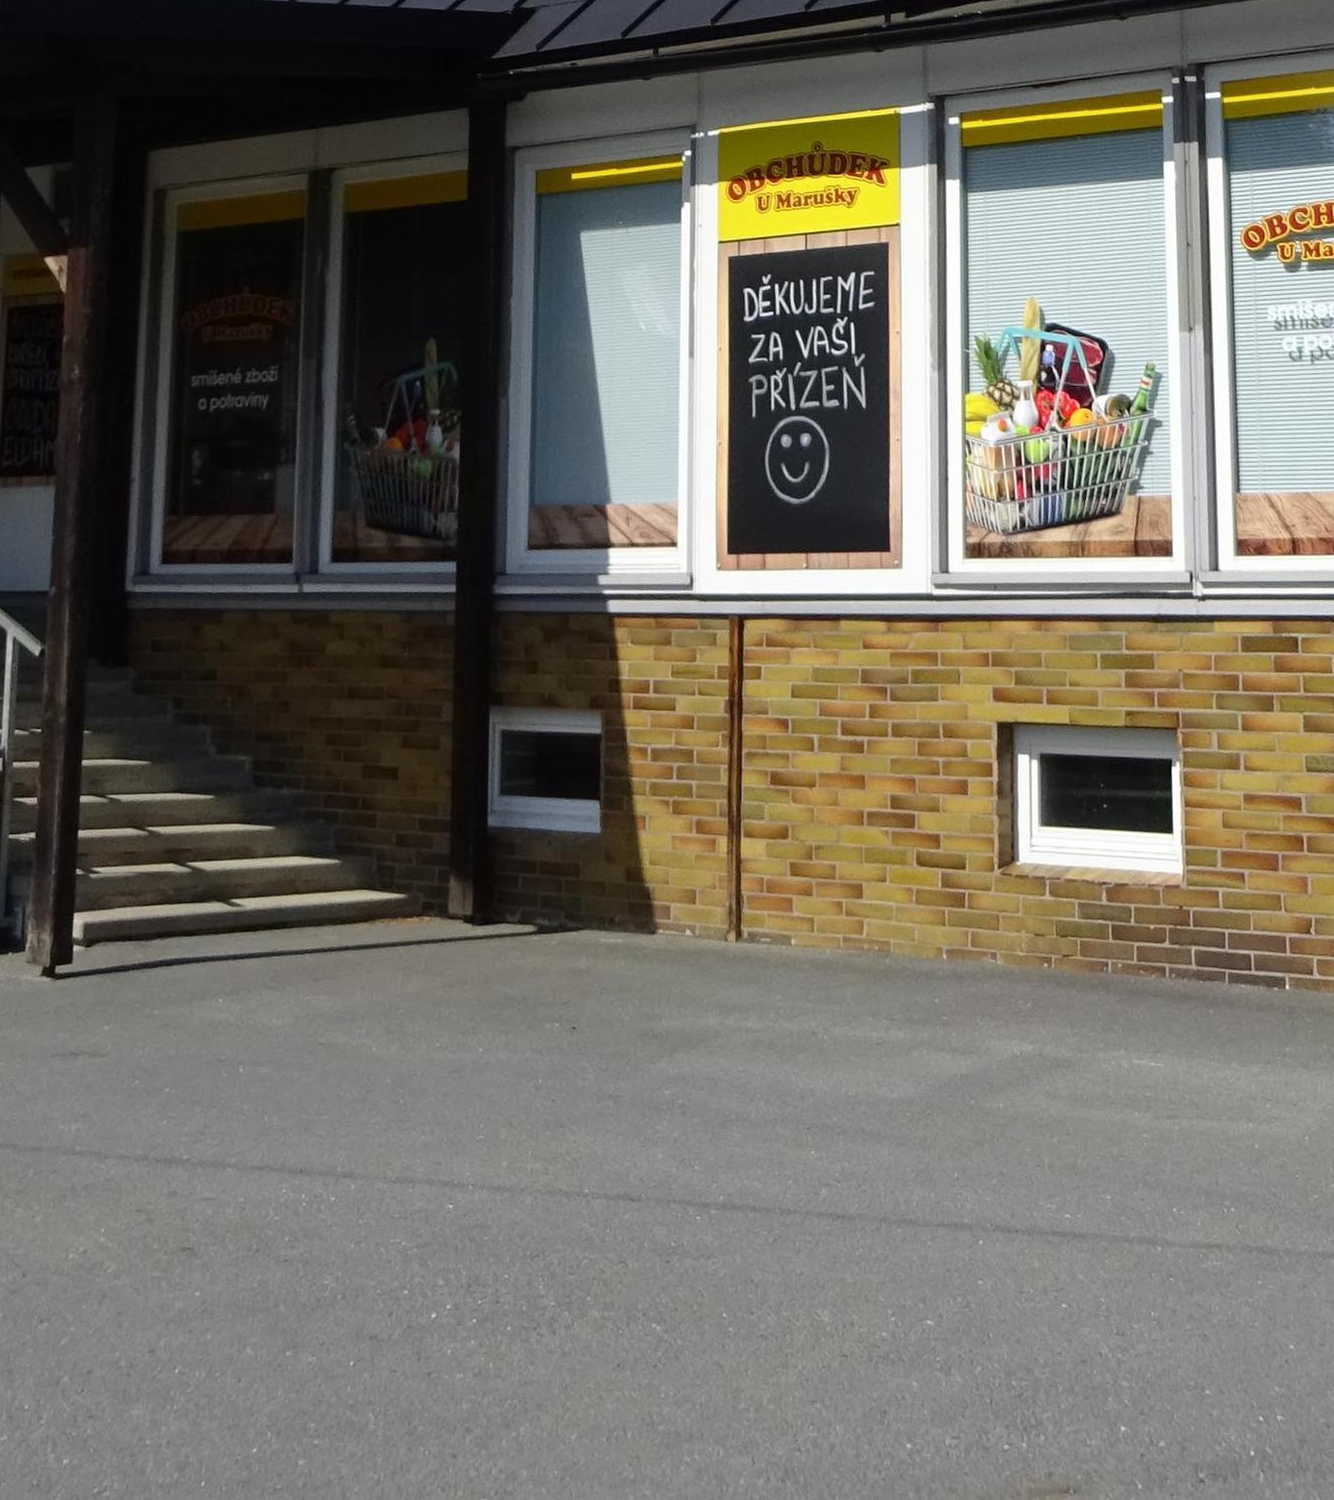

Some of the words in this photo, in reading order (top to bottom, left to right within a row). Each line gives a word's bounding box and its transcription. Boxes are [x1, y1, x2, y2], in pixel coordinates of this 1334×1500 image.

[726, 141, 890, 203] OBCHŮDEK
[756, 194, 771, 214] U
[774, 185, 860, 212] Marušky
[1277, 242, 1296, 264] U
[743, 271, 875, 322] DĚKUJEME
[748, 332, 784, 364] ZA
[795, 316, 856, 359] VAŠI
[748, 353, 867, 418] PŘÍZEŇ
